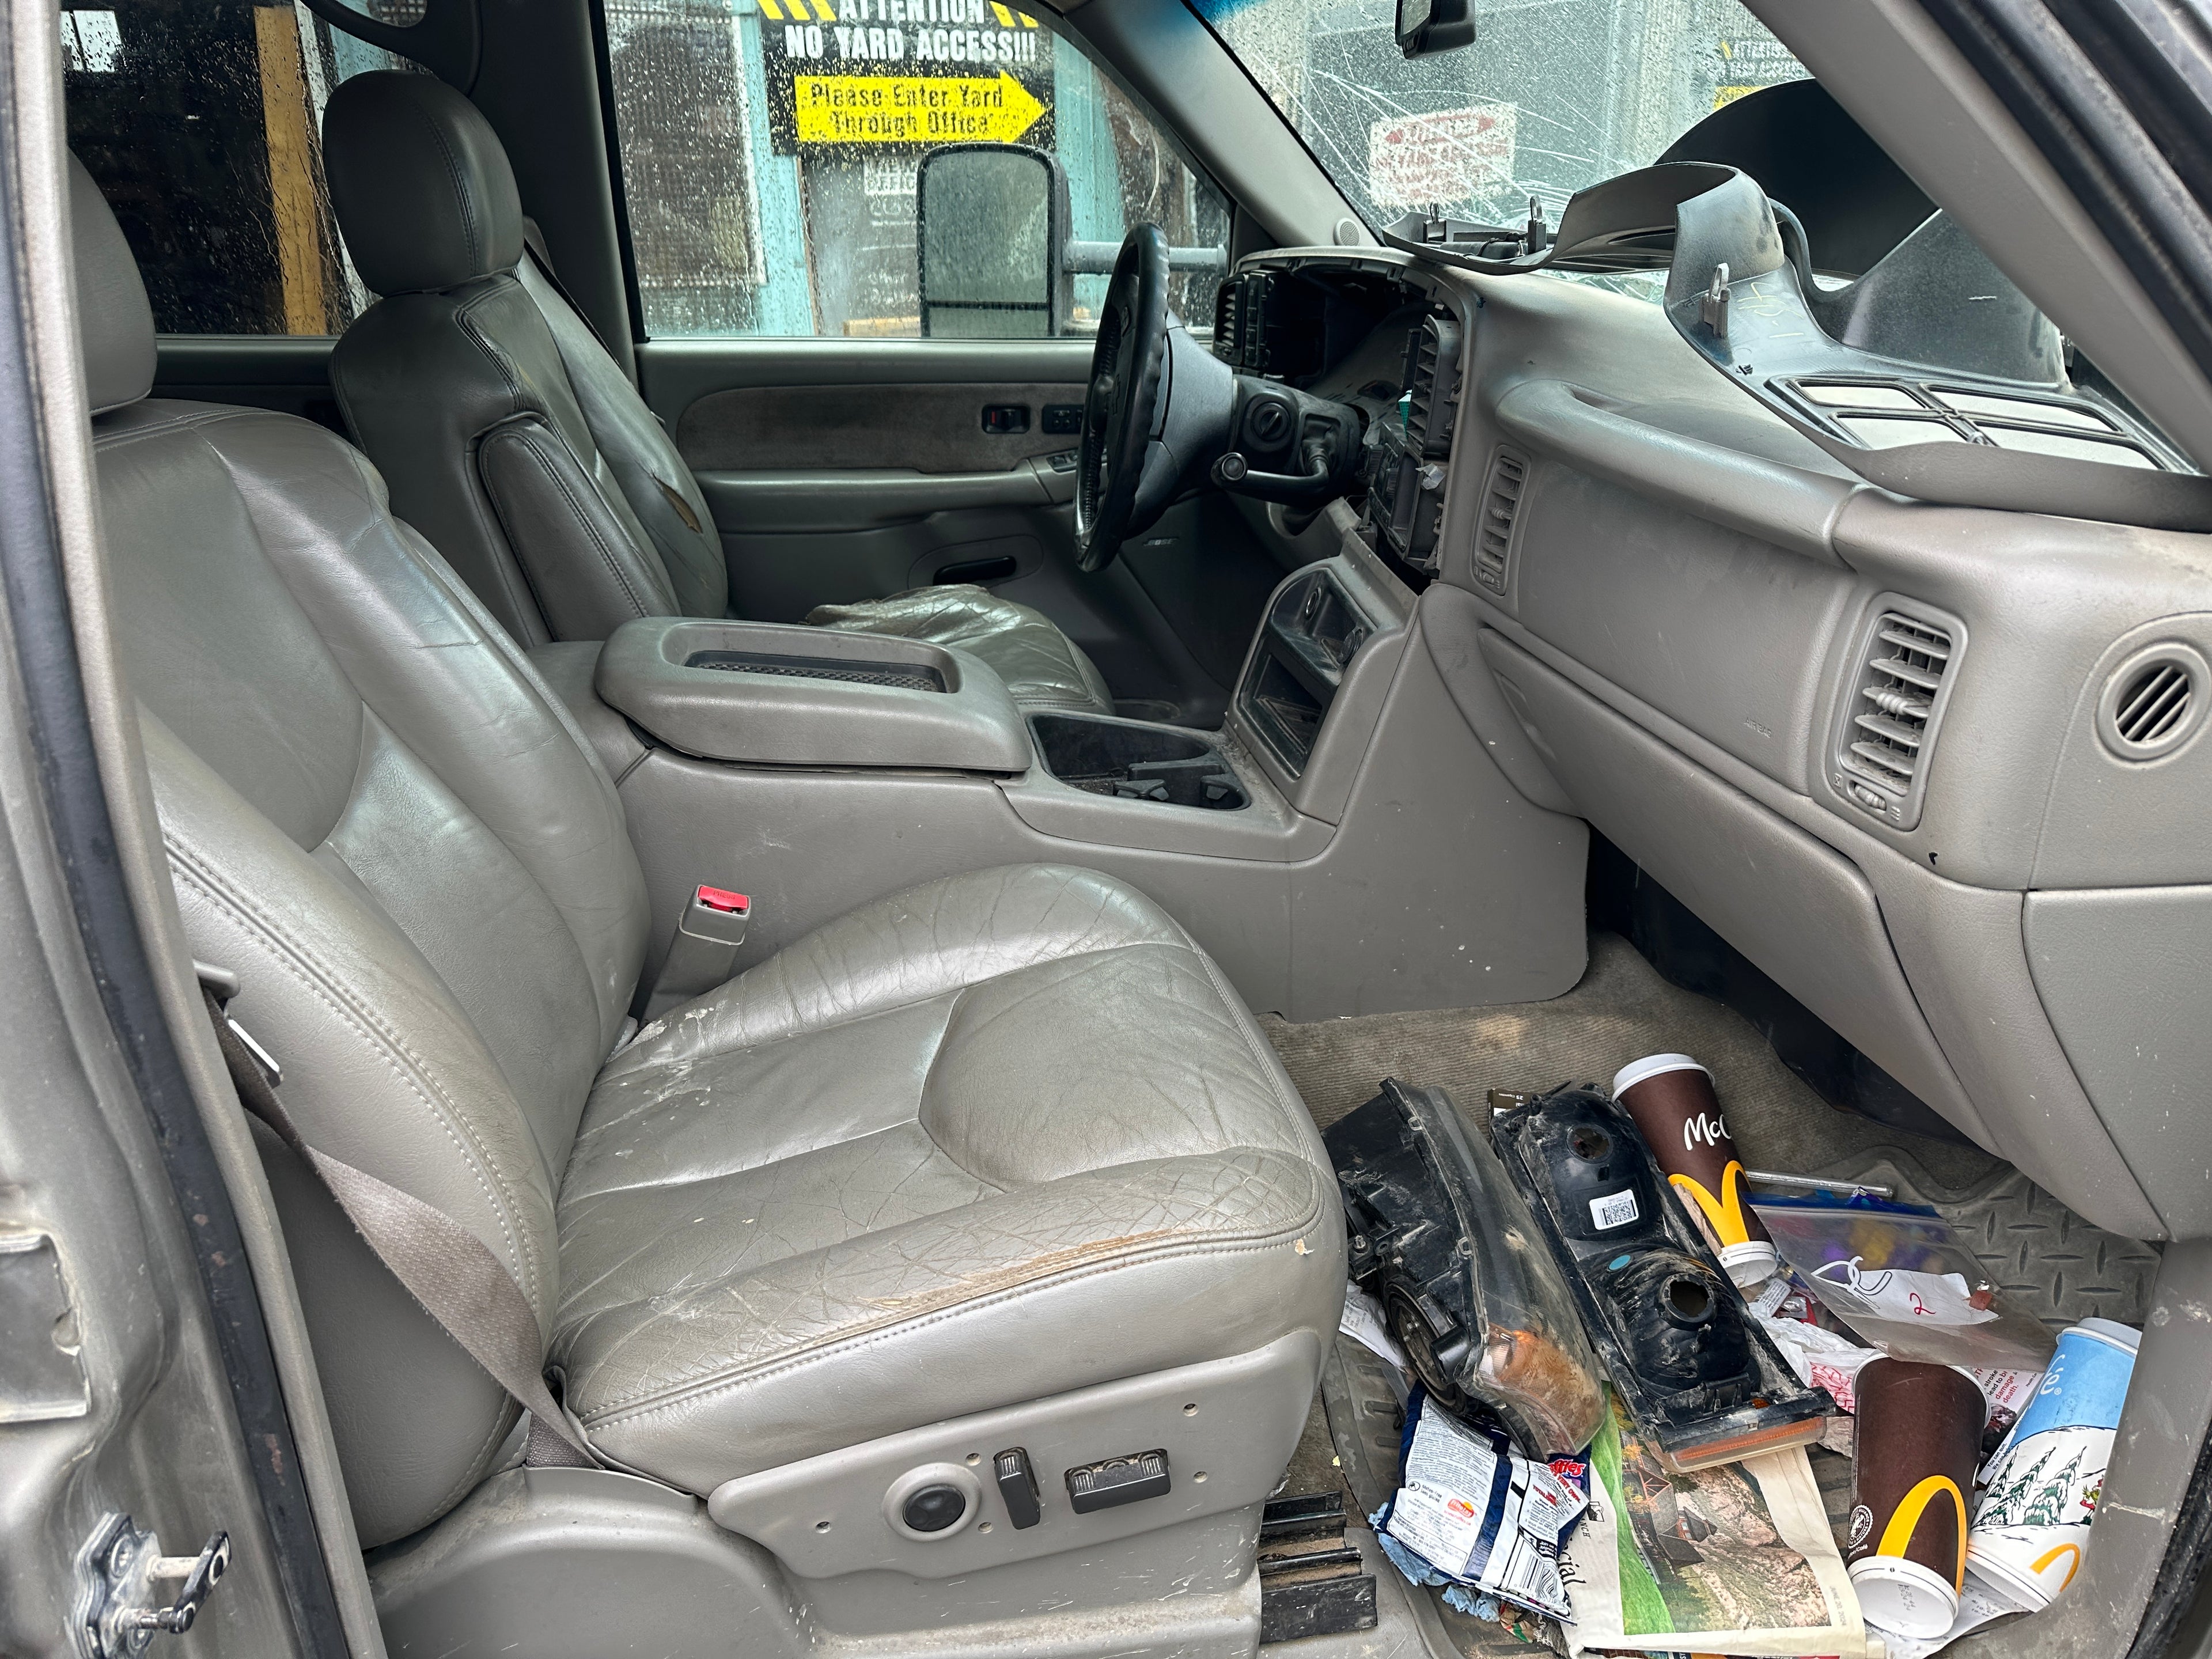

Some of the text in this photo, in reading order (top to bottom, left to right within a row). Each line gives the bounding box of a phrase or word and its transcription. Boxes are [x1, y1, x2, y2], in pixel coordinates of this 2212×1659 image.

[839, 0, 984, 24] ATTENTION
[785, 25, 1036, 62] NO YARD ACCESS!!!
[811, 83, 1003, 108] Please Enter Yard
[831, 111, 988, 138] Through Office
[713, 890, 736, 900] PRESS
[1910, 1293, 1936, 1315] 2
[1984, 1370, 1998, 1387] stroke
[1987, 1384, 1998, 1396] lead
[1995, 1375, 2014, 1399] damage
[2003, 1385, 2018, 1403] death.
